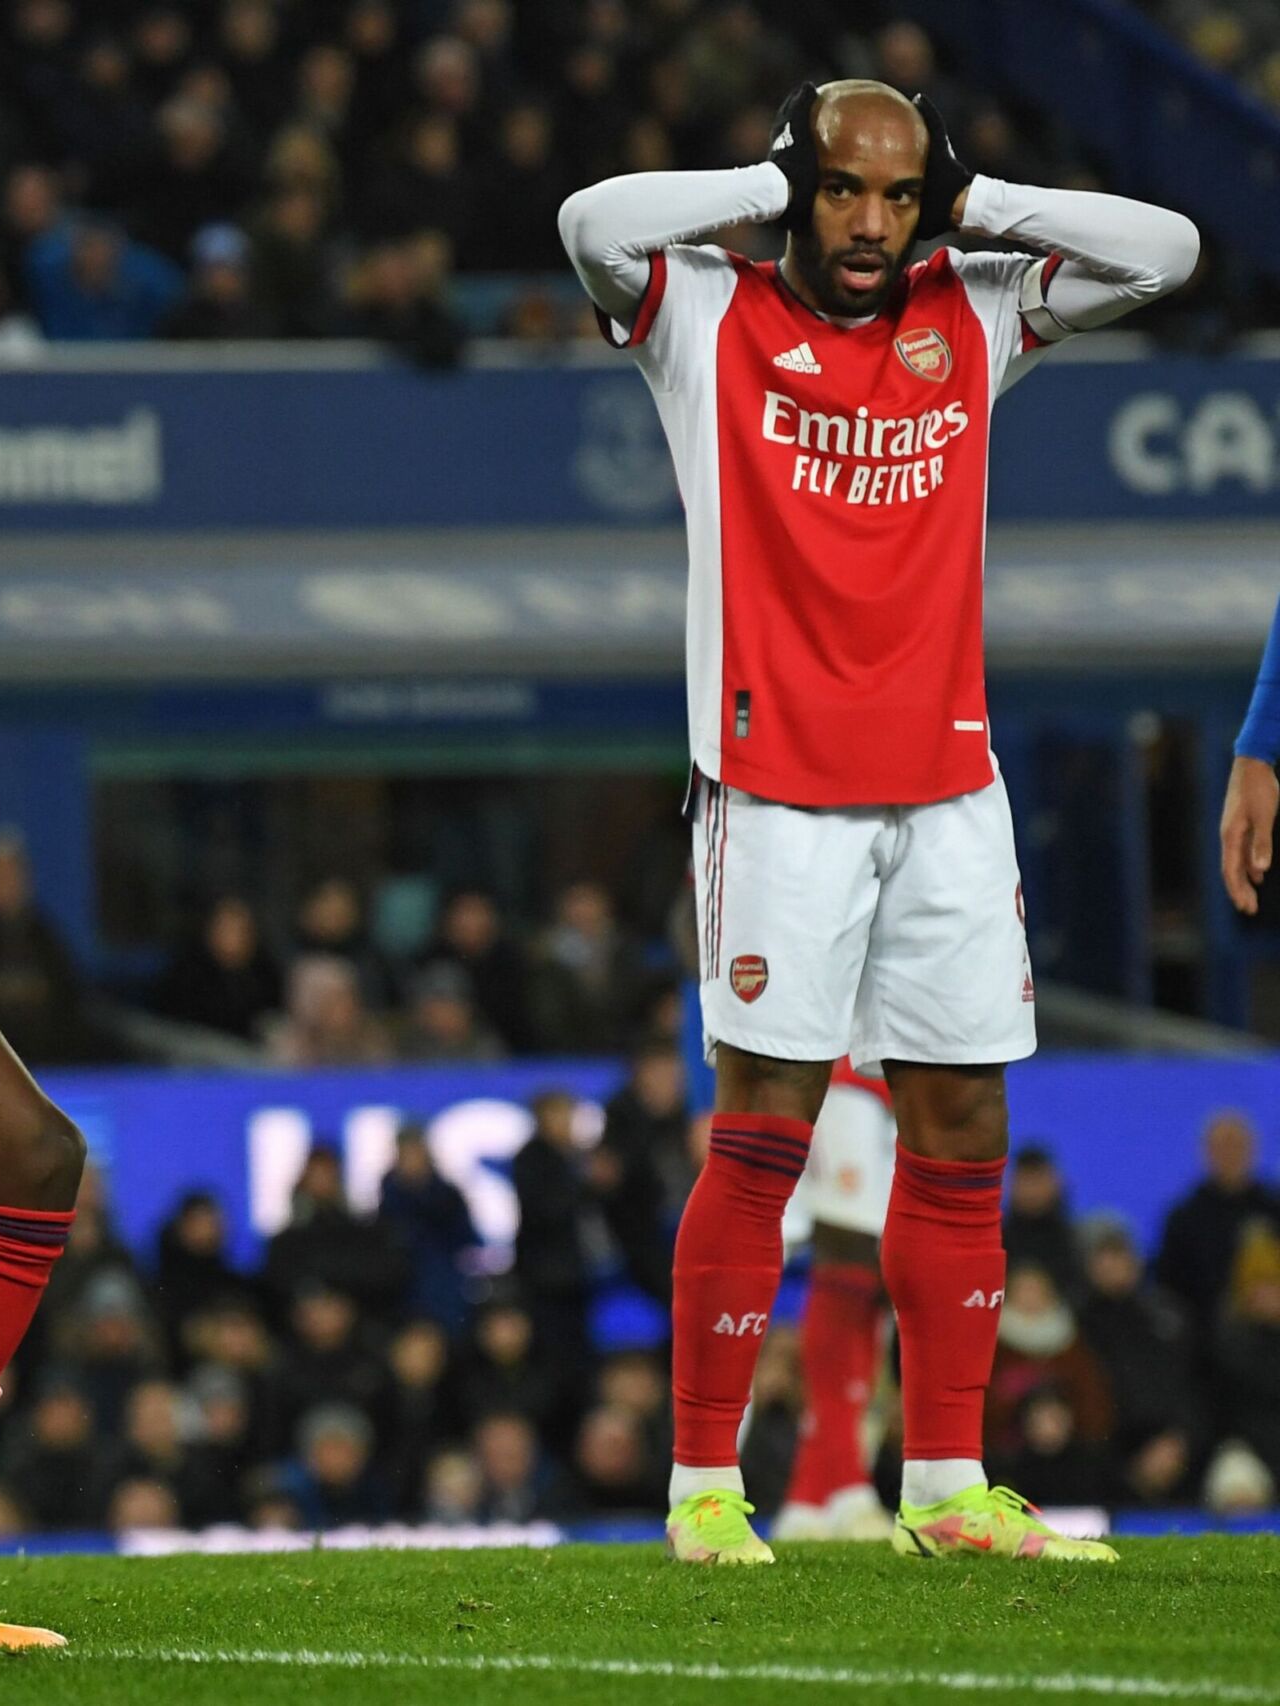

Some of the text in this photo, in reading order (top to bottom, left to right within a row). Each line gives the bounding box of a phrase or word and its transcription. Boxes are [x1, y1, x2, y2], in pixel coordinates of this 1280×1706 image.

[773, 355, 822, 375] adidas
[762, 390, 968, 458] Emirates
[1107, 390, 1280, 496] CA
[792, 454, 944, 505] FLY BETTER
[963, 1288, 1005, 1309] AF
[713, 1311, 767, 1337] AFC
